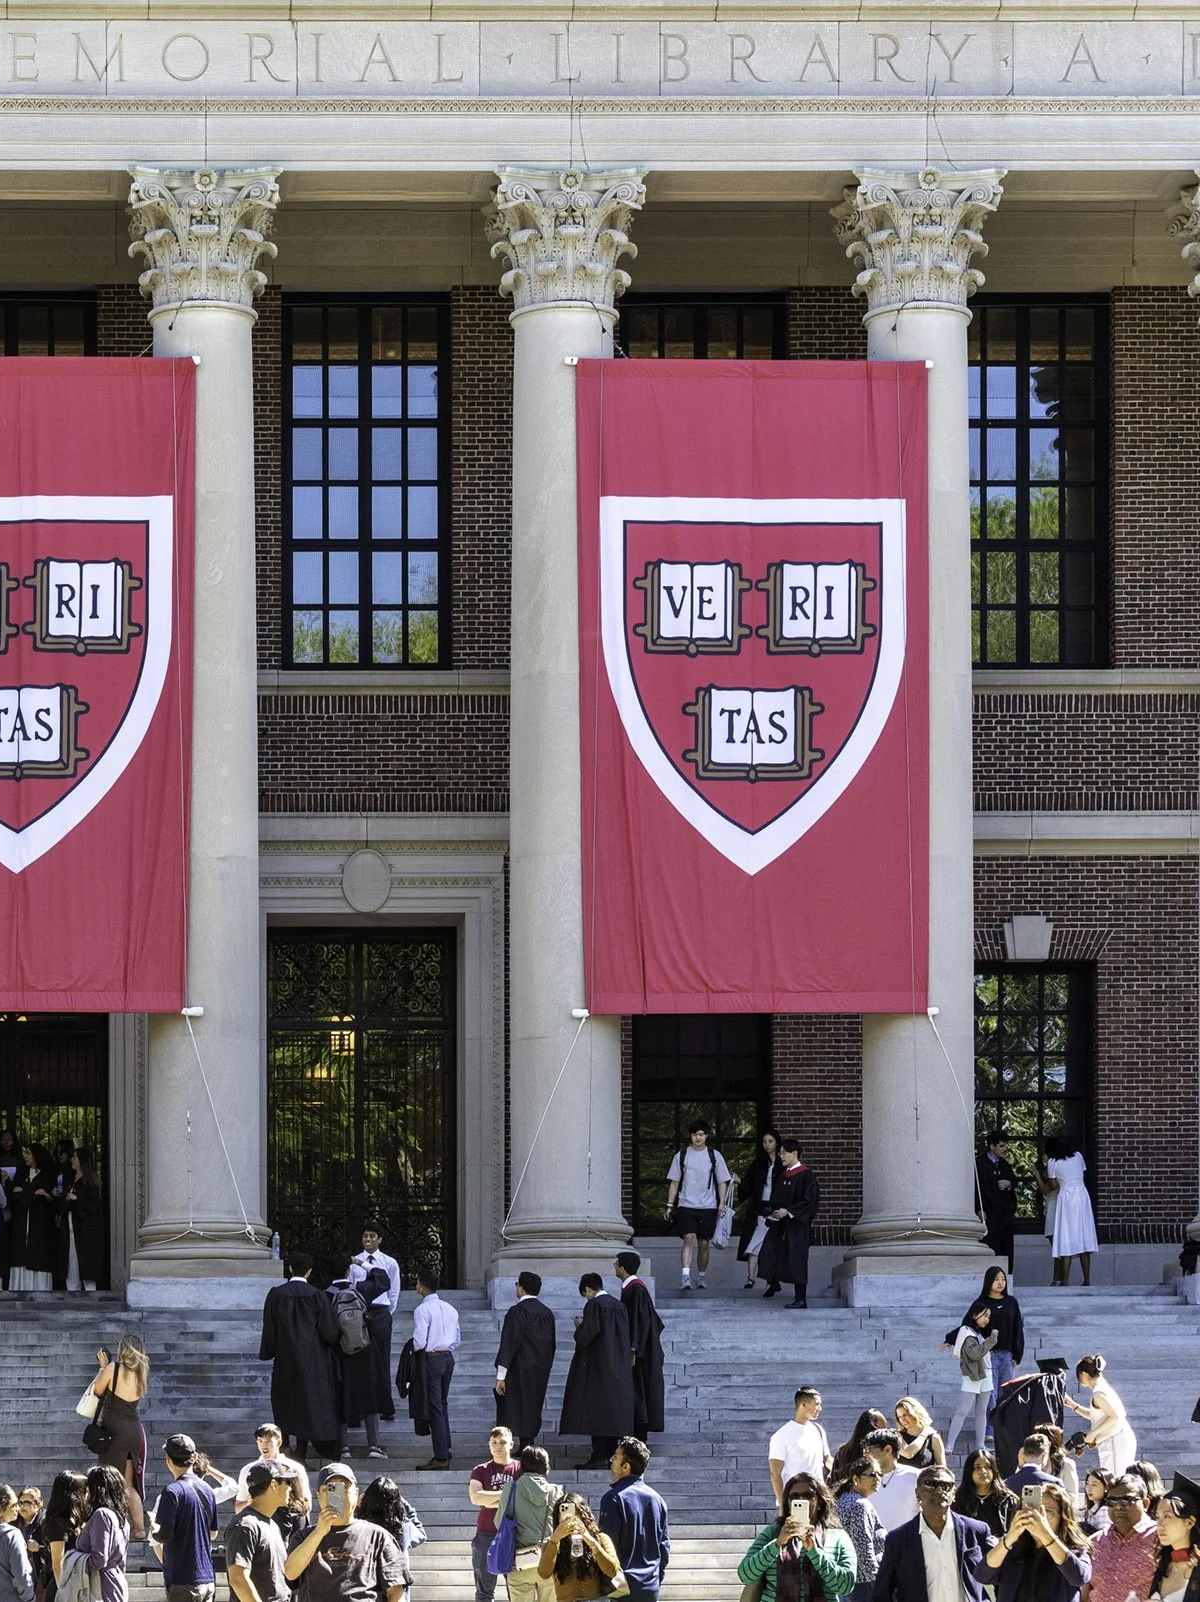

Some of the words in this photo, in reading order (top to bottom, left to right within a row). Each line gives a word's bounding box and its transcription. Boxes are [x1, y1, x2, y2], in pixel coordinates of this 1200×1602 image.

[550, 32, 975, 84] LIBRARY
[1058, 33, 1107, 83] A
[55, 584, 100, 618] RI
[662, 586, 716, 620] VE
[789, 586, 834, 620] RI
[719, 708, 787, 744] TAS
